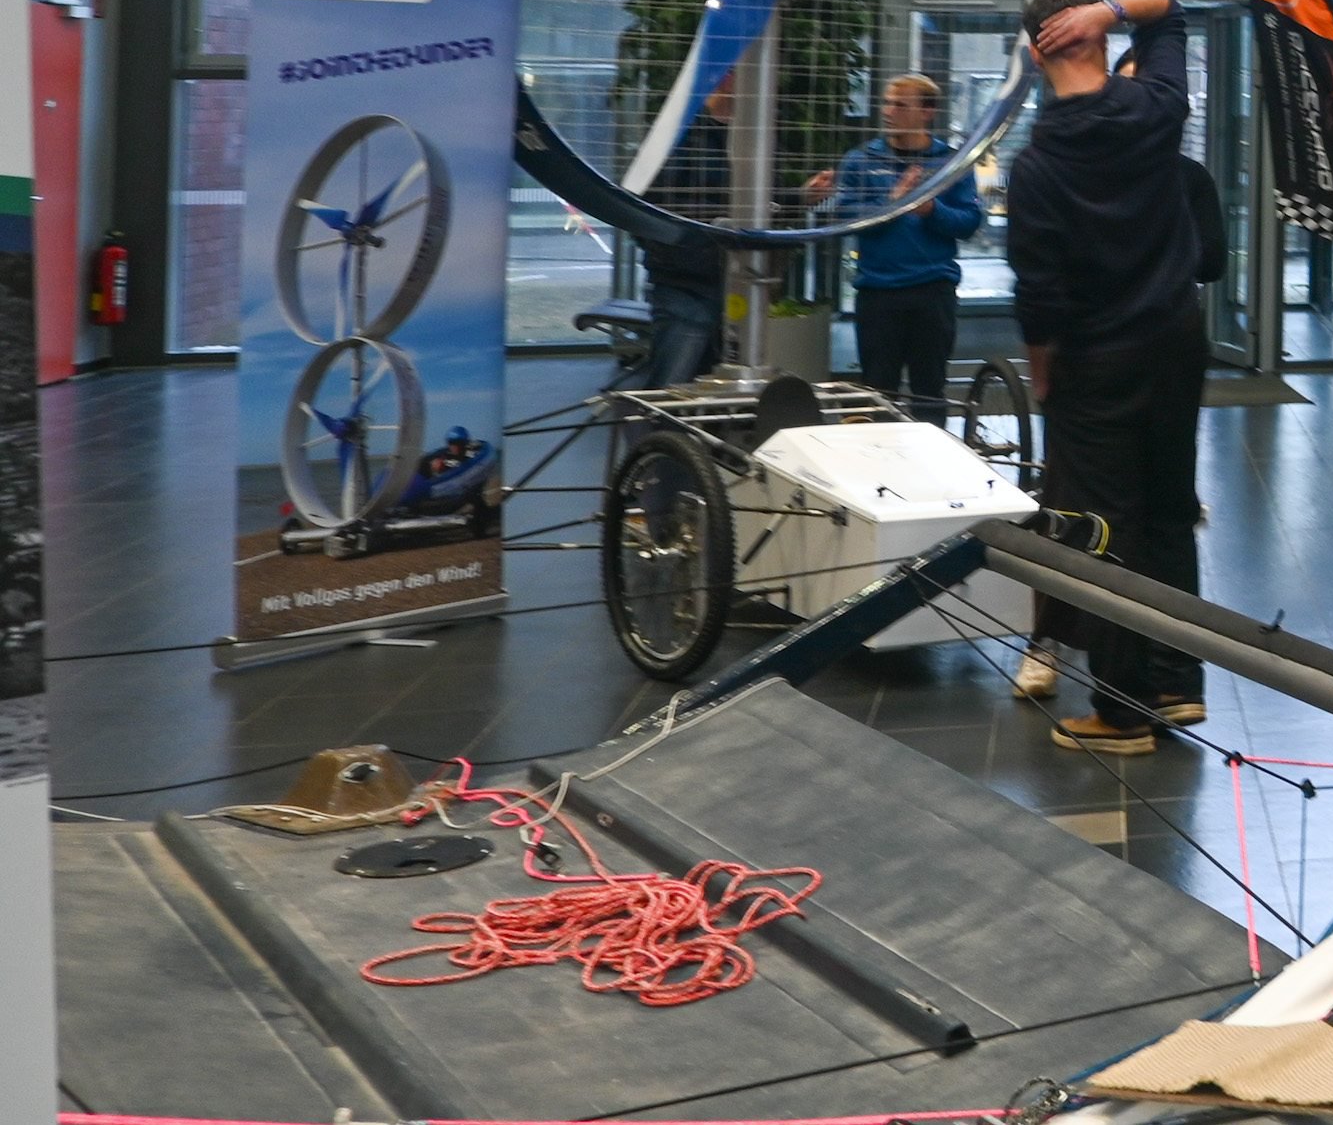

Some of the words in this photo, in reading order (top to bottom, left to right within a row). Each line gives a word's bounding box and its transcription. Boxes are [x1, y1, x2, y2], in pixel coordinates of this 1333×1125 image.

[261, 595, 291, 613] Mit
[293, 587, 353, 607] Vollgas
[353, 578, 403, 601] gegen
[404, 572, 435, 589] den
